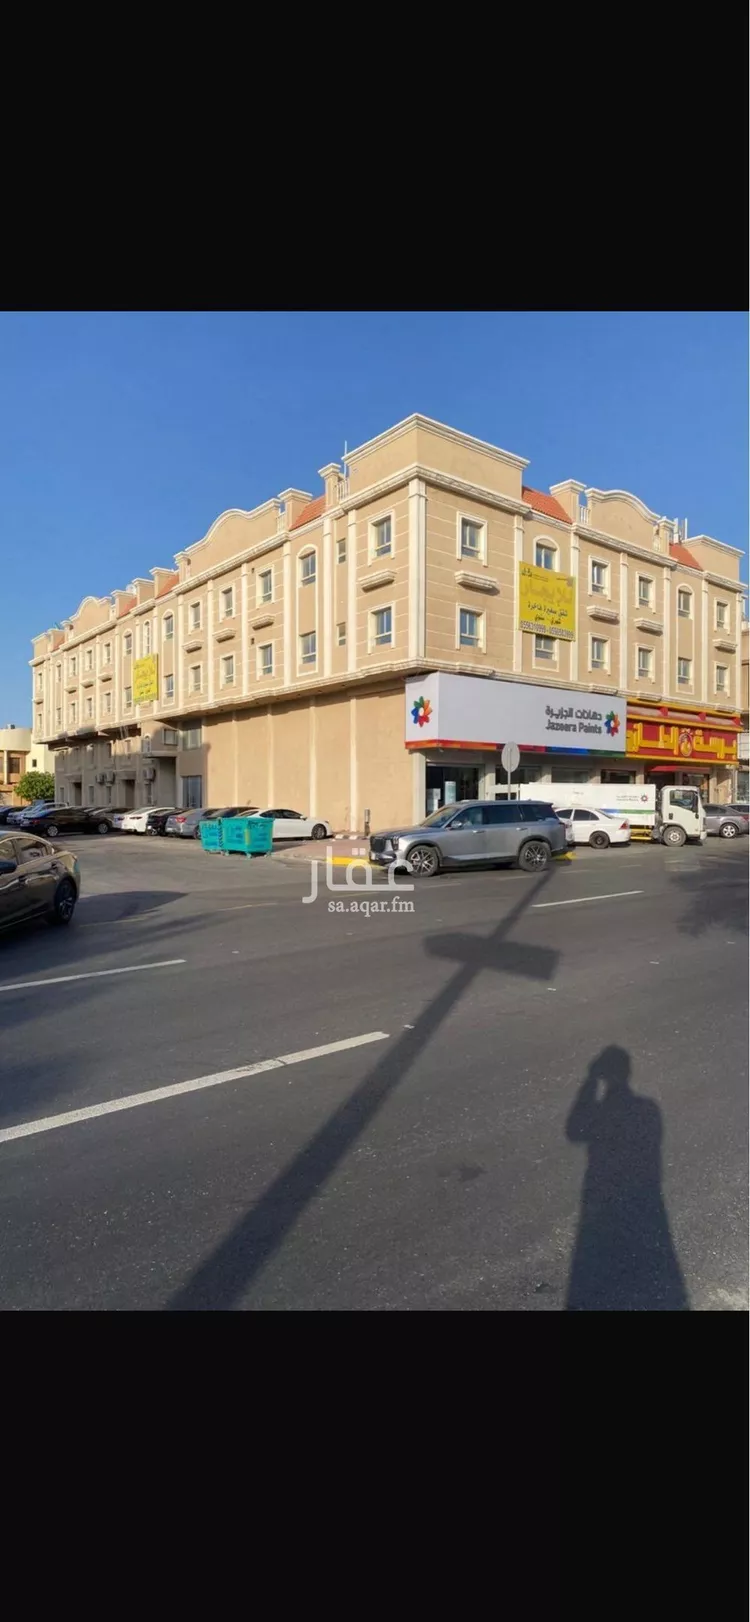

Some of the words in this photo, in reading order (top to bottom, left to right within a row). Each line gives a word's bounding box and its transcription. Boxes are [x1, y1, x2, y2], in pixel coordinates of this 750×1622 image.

[545, 705, 574, 720] الجزيرة
[575, 708, 603, 721] دهانات
[545, 719, 577, 733] Jazeera
[578, 722, 602, 734] Paints
